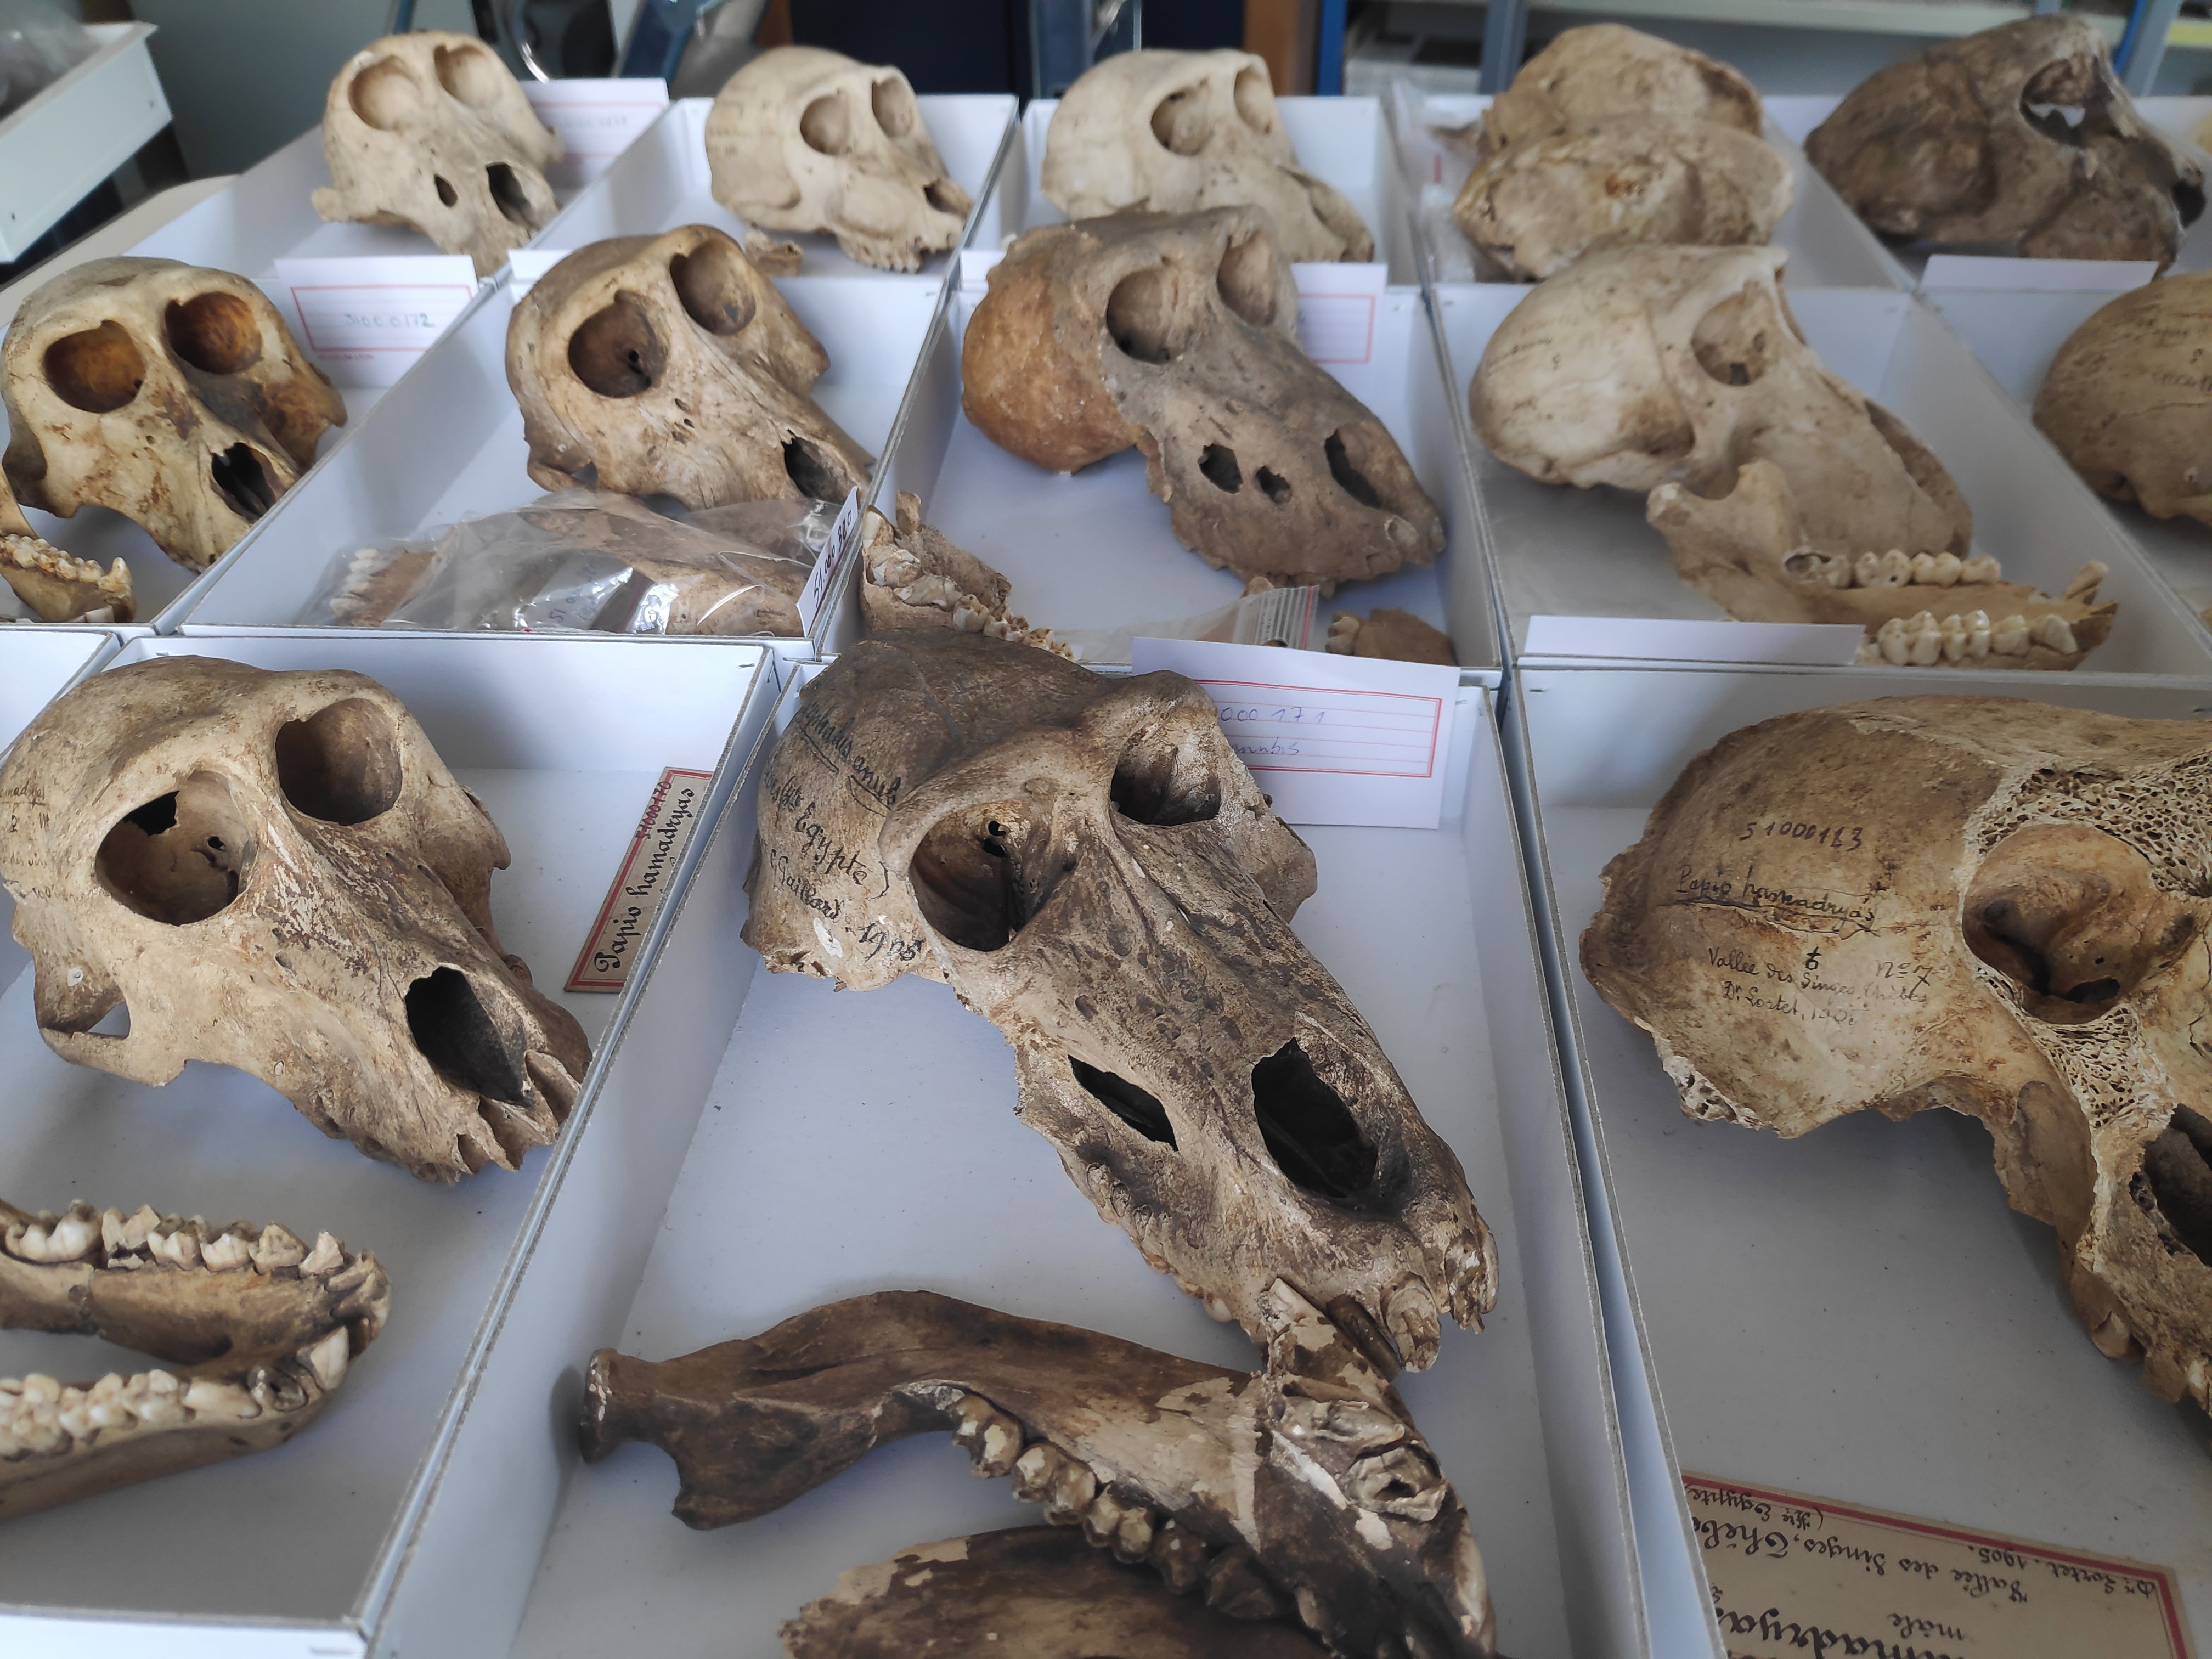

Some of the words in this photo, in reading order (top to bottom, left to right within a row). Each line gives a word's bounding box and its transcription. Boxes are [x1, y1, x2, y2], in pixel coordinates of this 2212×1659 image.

[594, 906, 642, 973] Papio
[625, 788, 695, 896] hamadryas
[1898, 1558, 1939, 1580] des
